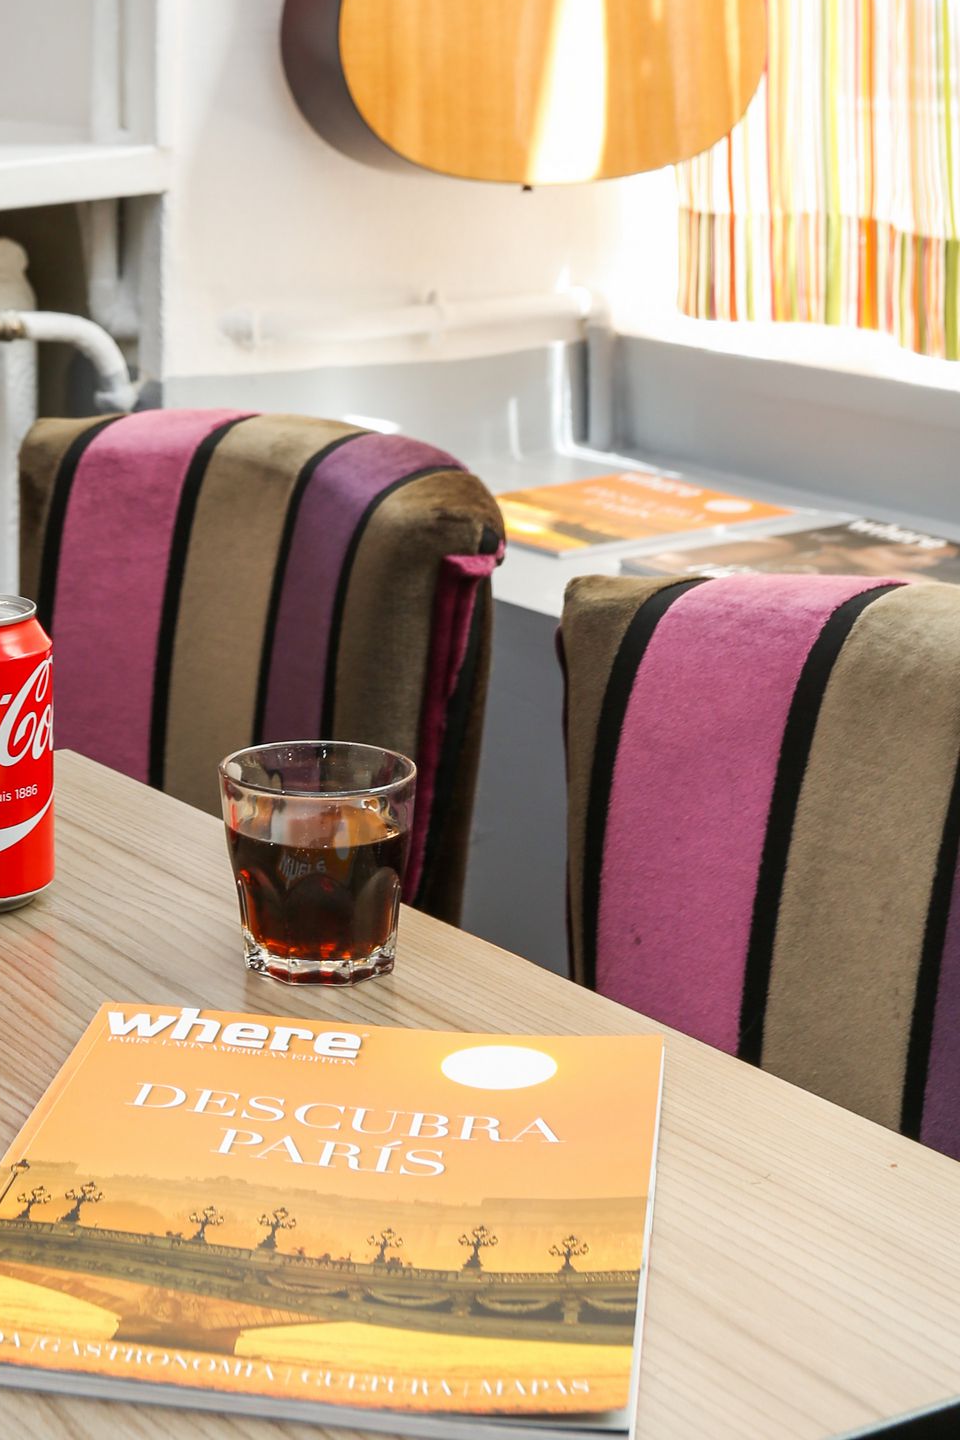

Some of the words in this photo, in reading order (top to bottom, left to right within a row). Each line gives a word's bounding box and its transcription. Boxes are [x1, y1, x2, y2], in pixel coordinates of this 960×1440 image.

[15, 784, 38, 800] 1886
[107, 1035, 150, 1045] PARIS
[162, 1039, 205, 1050] LATIN
[211, 1045, 289, 1060] AMERICAN
[292, 1053, 356, 1067] EDITION
[108, 1007, 362, 1059] where
[124, 1082, 567, 1144] DESCUBRA
[210, 1127, 446, 1177] PARÍS
[480, 1377, 590, 1396] MAPAS
